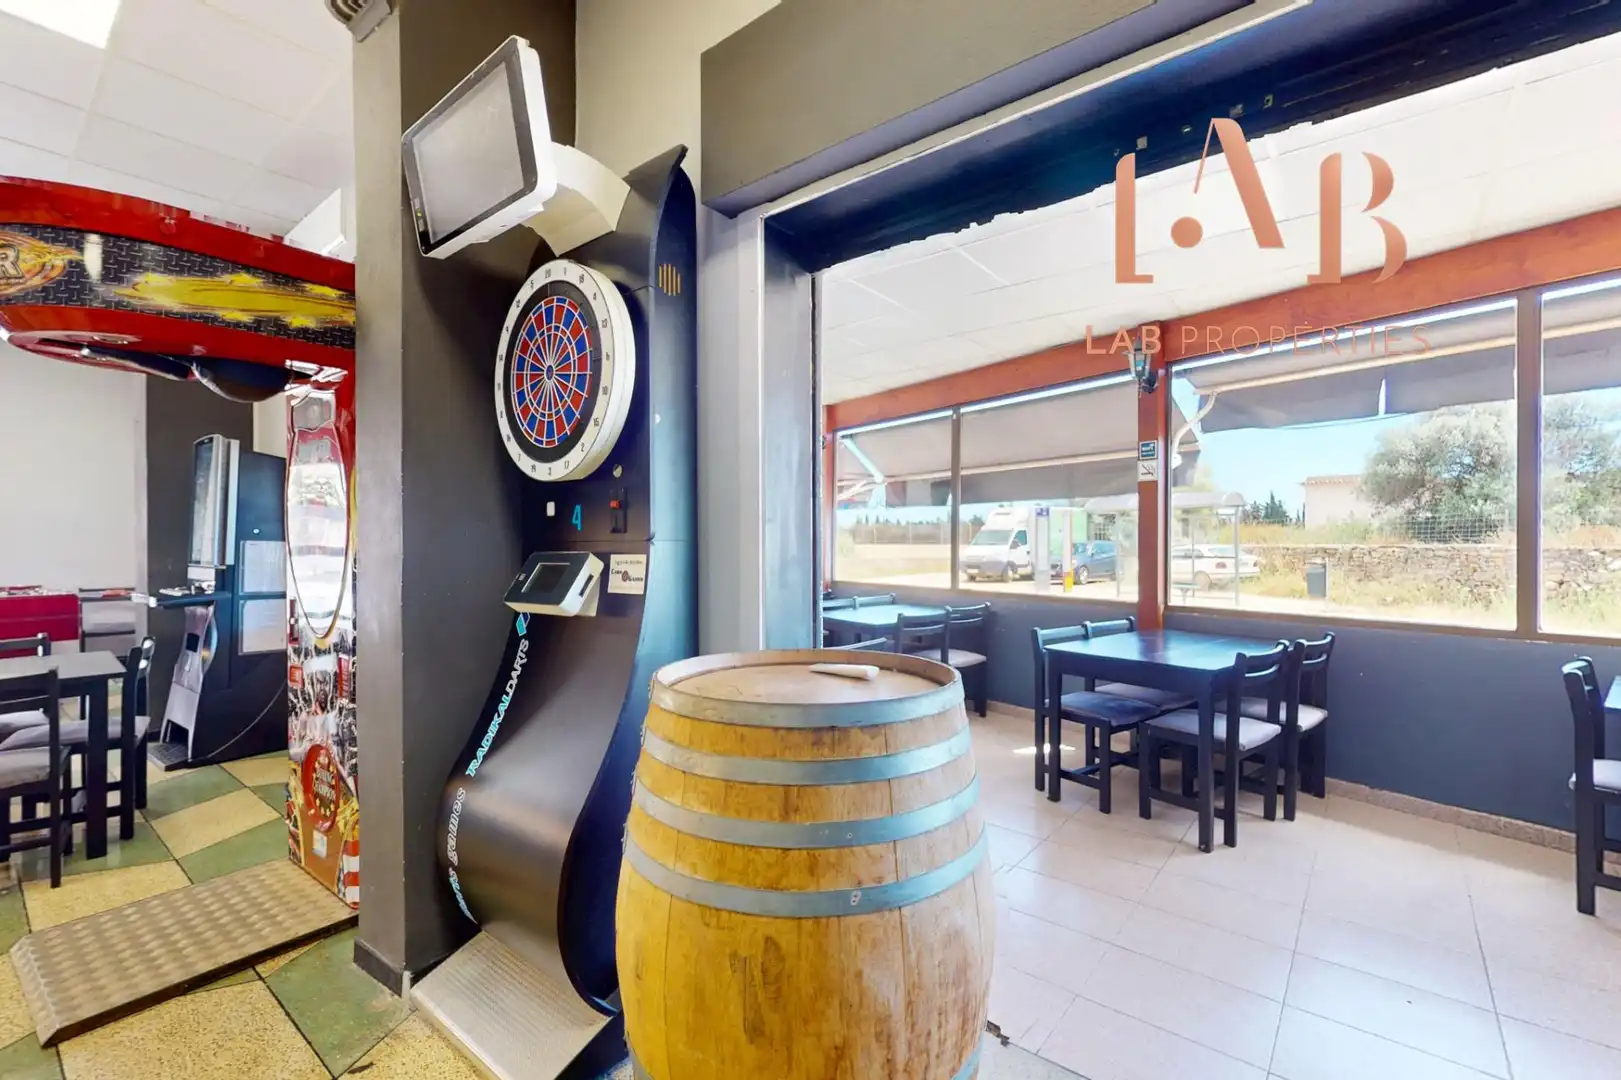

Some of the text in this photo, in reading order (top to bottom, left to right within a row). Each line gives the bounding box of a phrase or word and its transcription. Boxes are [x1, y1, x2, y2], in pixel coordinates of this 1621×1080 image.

[593, 417, 600, 427] 15
[563, 460, 570, 469] 17
[571, 503, 583, 532] 4
[447, 787, 466, 866] games
